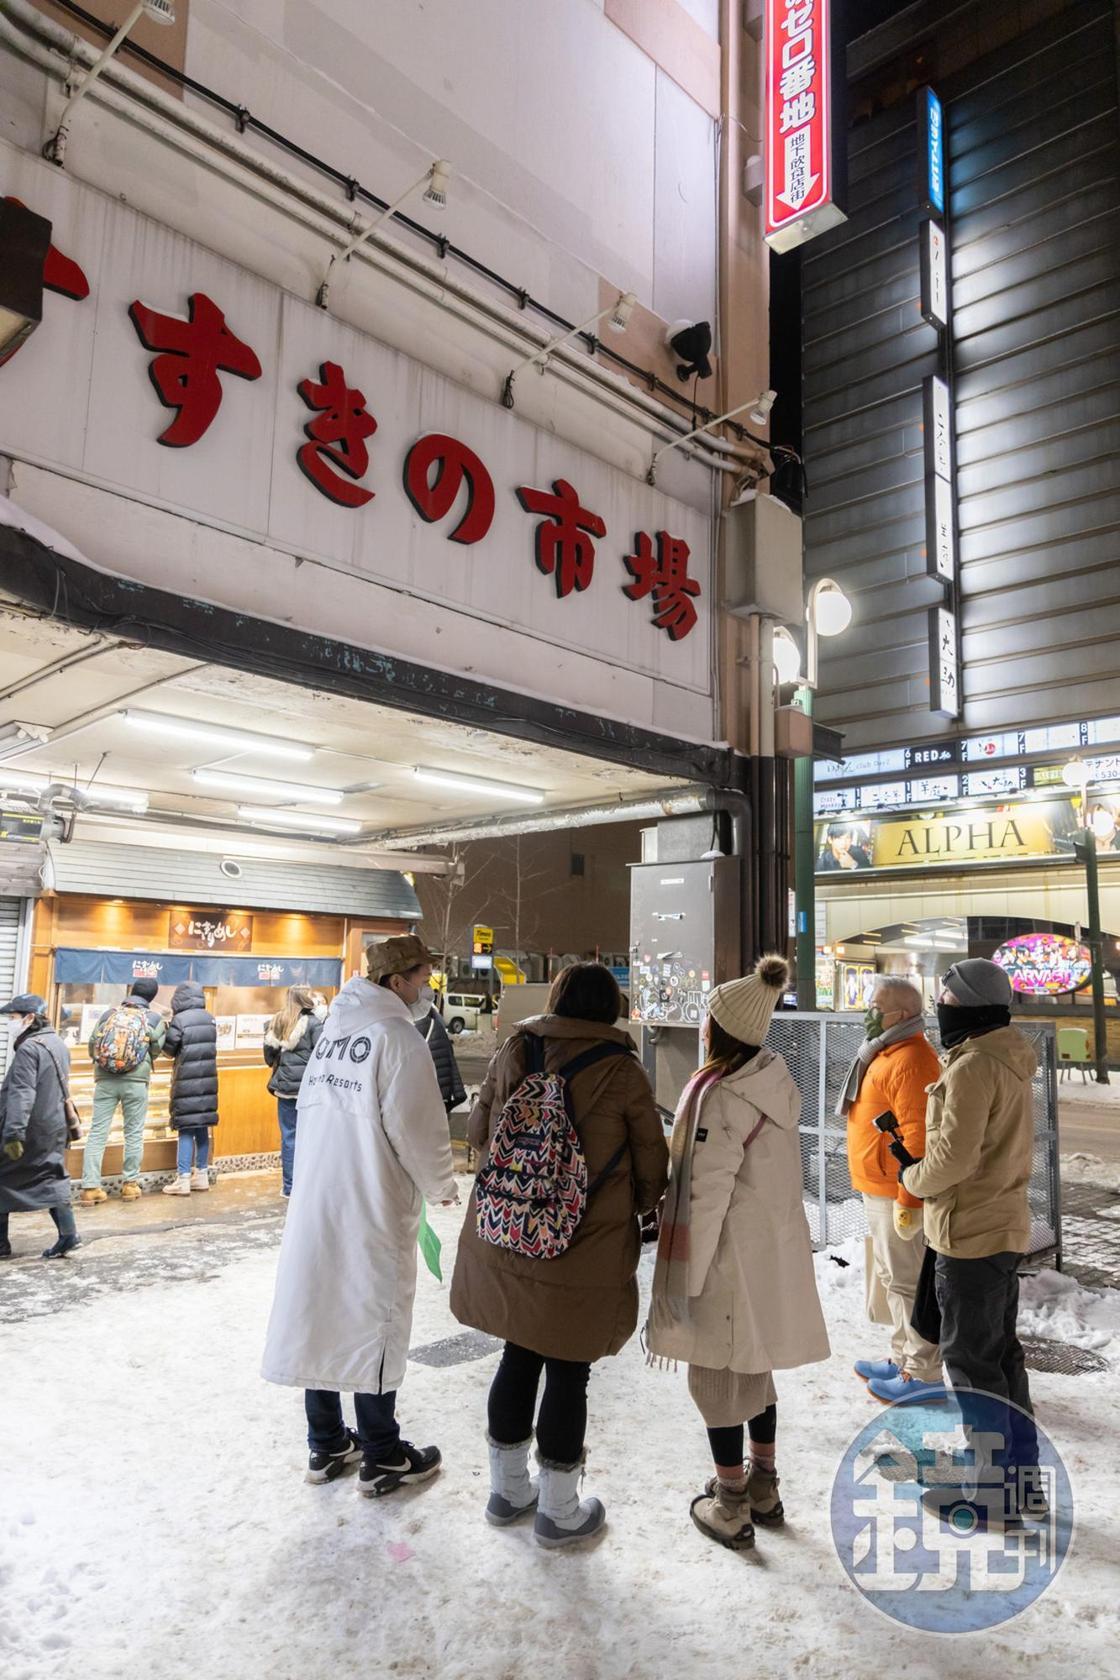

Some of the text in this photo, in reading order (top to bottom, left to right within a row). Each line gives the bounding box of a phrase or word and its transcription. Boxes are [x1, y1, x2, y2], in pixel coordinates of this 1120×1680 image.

[780, 0, 816, 134] ゼロ番地
[790, 133, 805, 203] 地下飲食店街
[0, 196, 702, 641] すきの市場
[1018, 732, 1025, 754] 7F
[1080, 723, 1088, 745] 8F
[914, 749, 939, 763] RED
[961, 740, 968, 762] 7F
[896, 820, 1026, 856] ALPHA
[316, 1035, 371, 1063] OMO
[326, 1074, 362, 1092] Resorts
